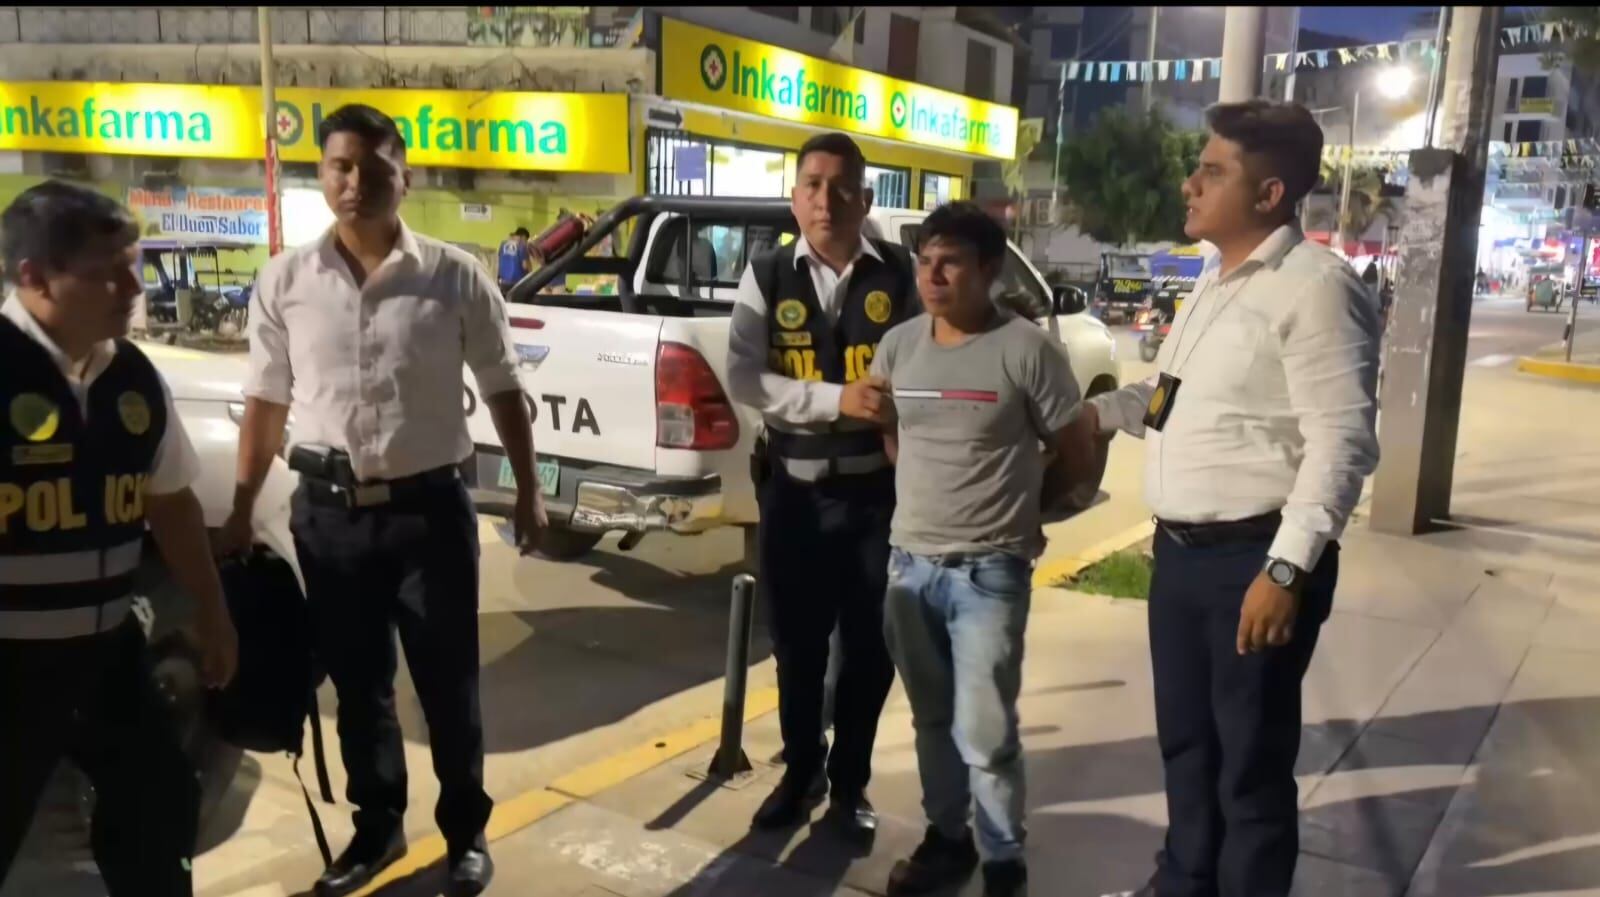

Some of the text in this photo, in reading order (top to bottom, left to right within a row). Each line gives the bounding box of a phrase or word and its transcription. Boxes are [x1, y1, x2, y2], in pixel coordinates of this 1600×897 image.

[731, 50, 868, 121] Inkafarma
[0, 95, 212, 141] nkafarma
[311, 102, 568, 154] Iafarma
[911, 95, 1002, 146] Inkafarma
[218, 216, 260, 236] Sabor
